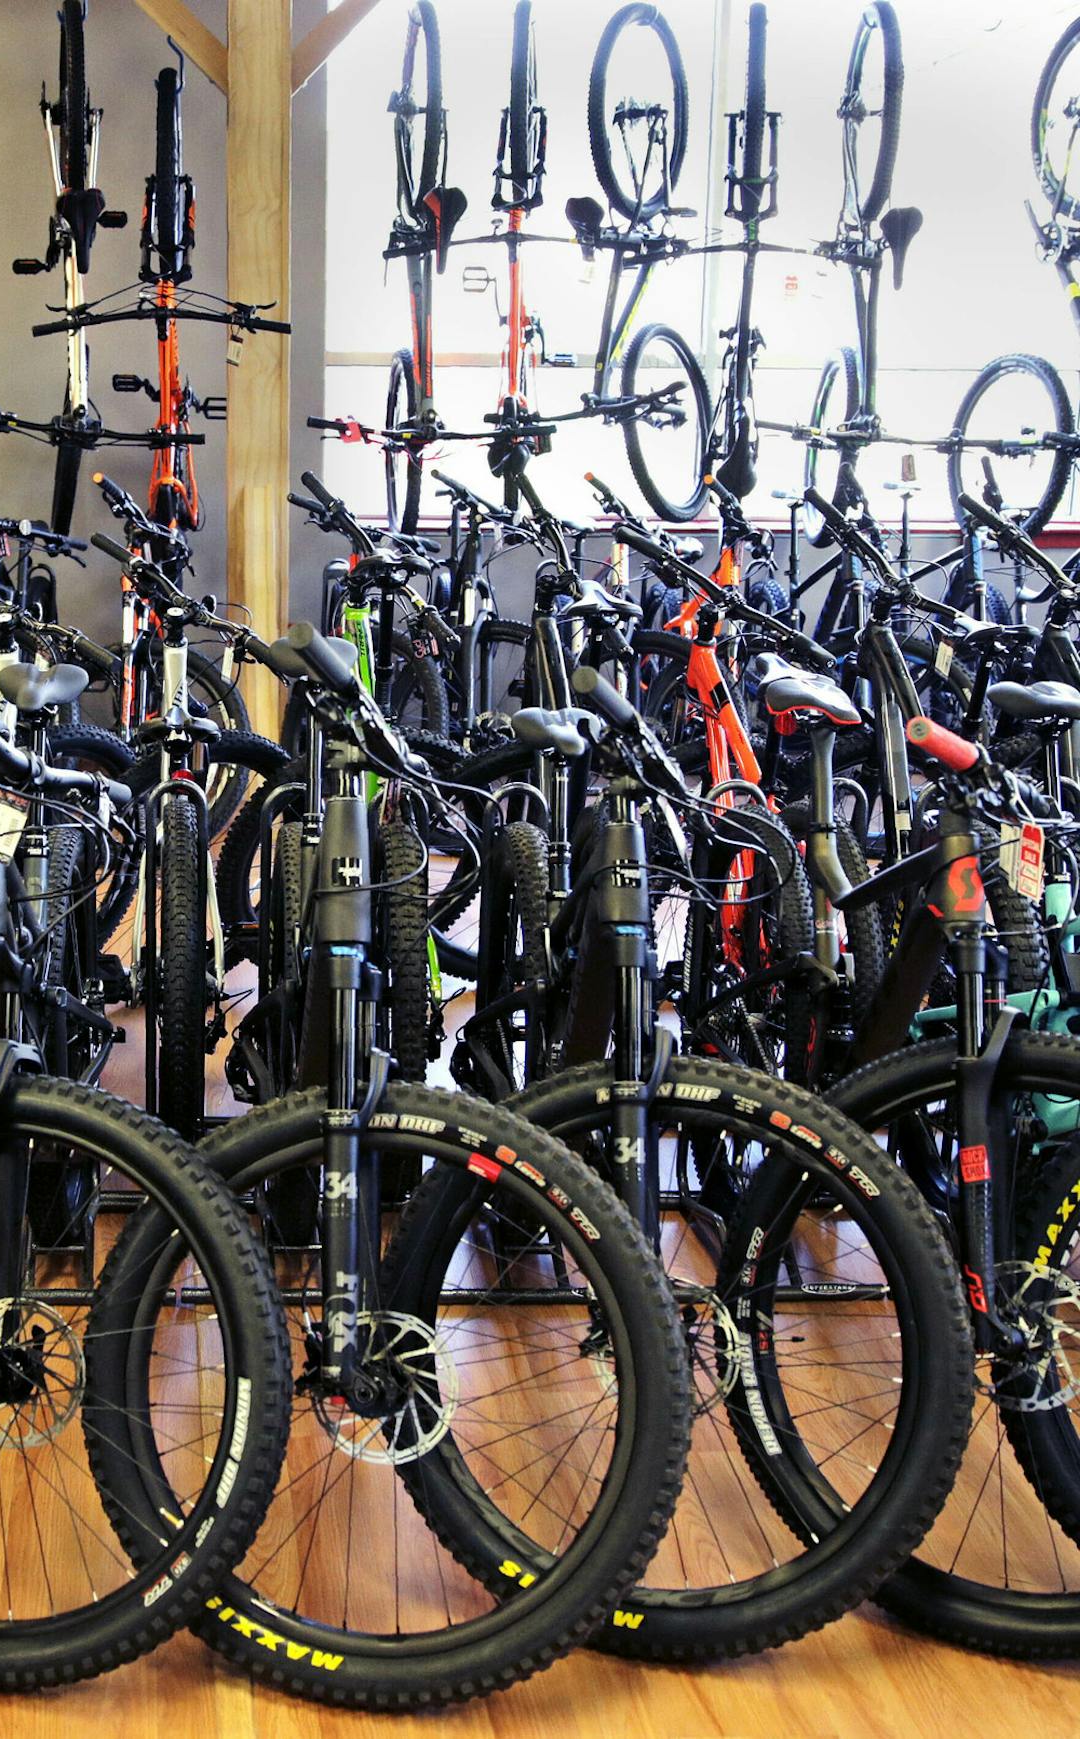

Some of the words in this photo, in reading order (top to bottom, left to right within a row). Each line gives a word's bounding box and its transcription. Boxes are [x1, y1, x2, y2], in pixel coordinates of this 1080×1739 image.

[325, 1171, 357, 1199] 34
[614, 1137, 645, 1164] 34
[326, 1271, 358, 1353] FOX
[229, 1376, 252, 1462] MINION
[745, 1389, 783, 1456] REKON
[206, 1596, 344, 1671] MAXXIS
